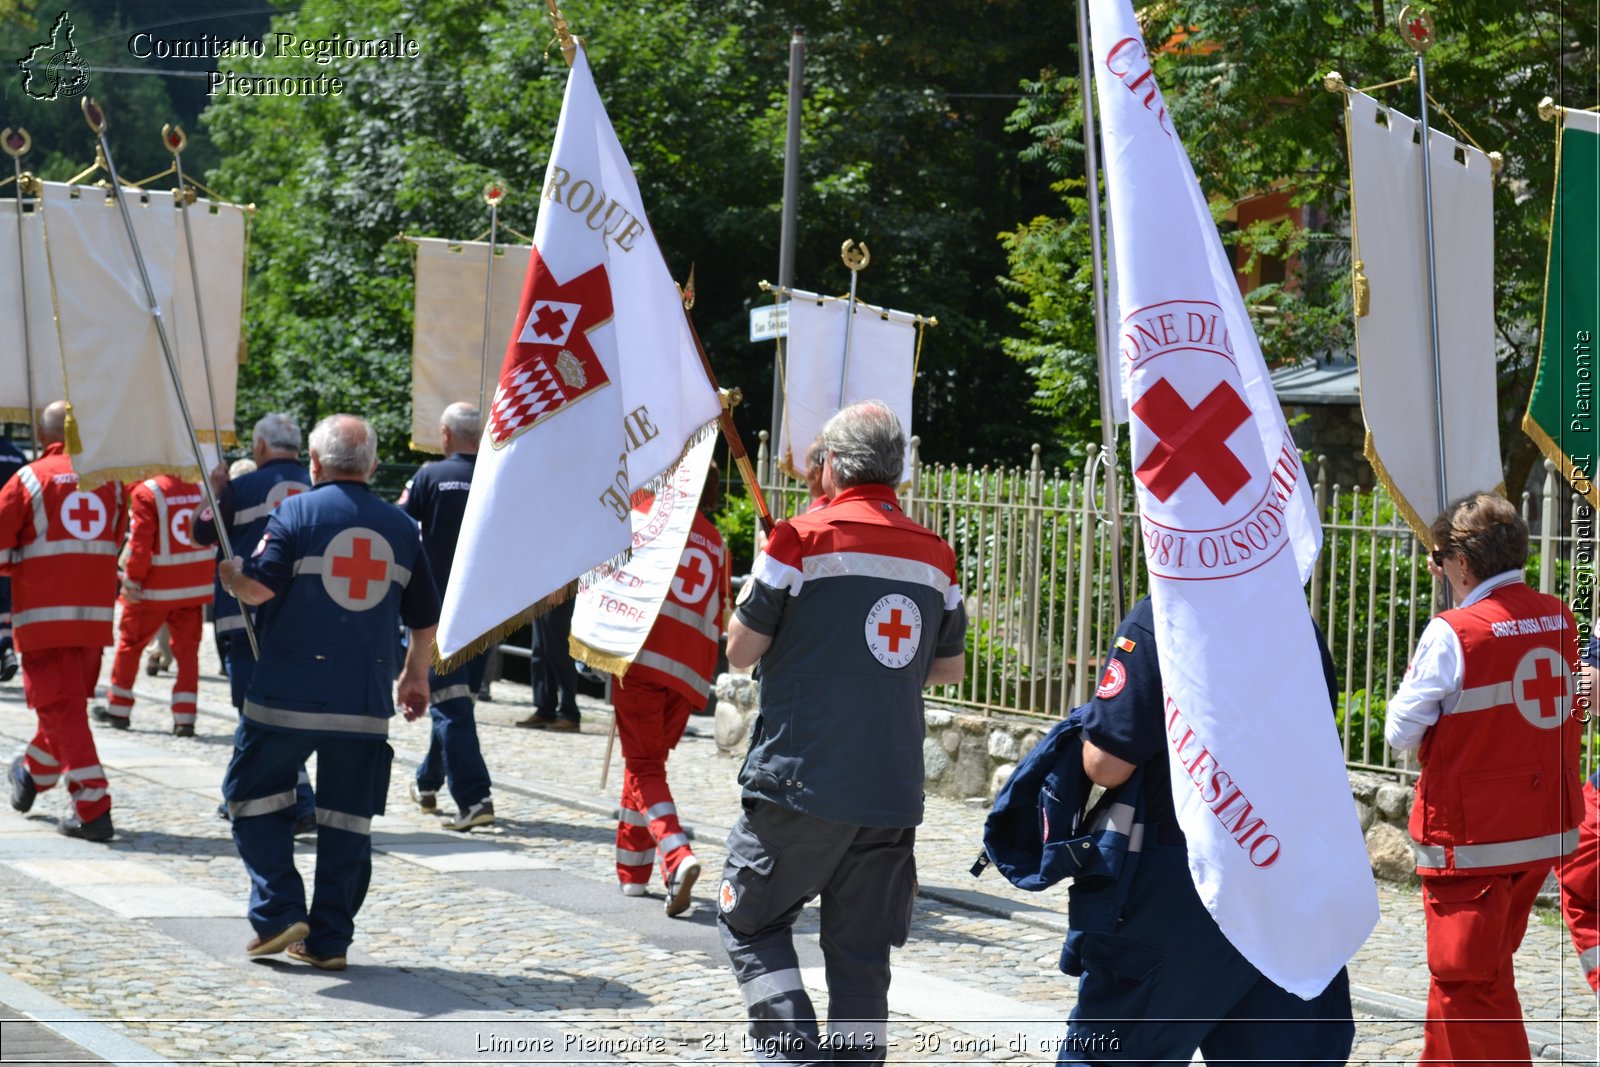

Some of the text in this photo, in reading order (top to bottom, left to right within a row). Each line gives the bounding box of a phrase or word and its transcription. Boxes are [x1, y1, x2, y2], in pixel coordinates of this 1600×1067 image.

[1187, 312, 1218, 345] DI
[867, 597, 891, 625] CROIX
[901, 597, 921, 629] ROUGE
[1491, 614, 1569, 638] CROCE ROSSA ITALIANA
[870, 642, 916, 667] MONACO
